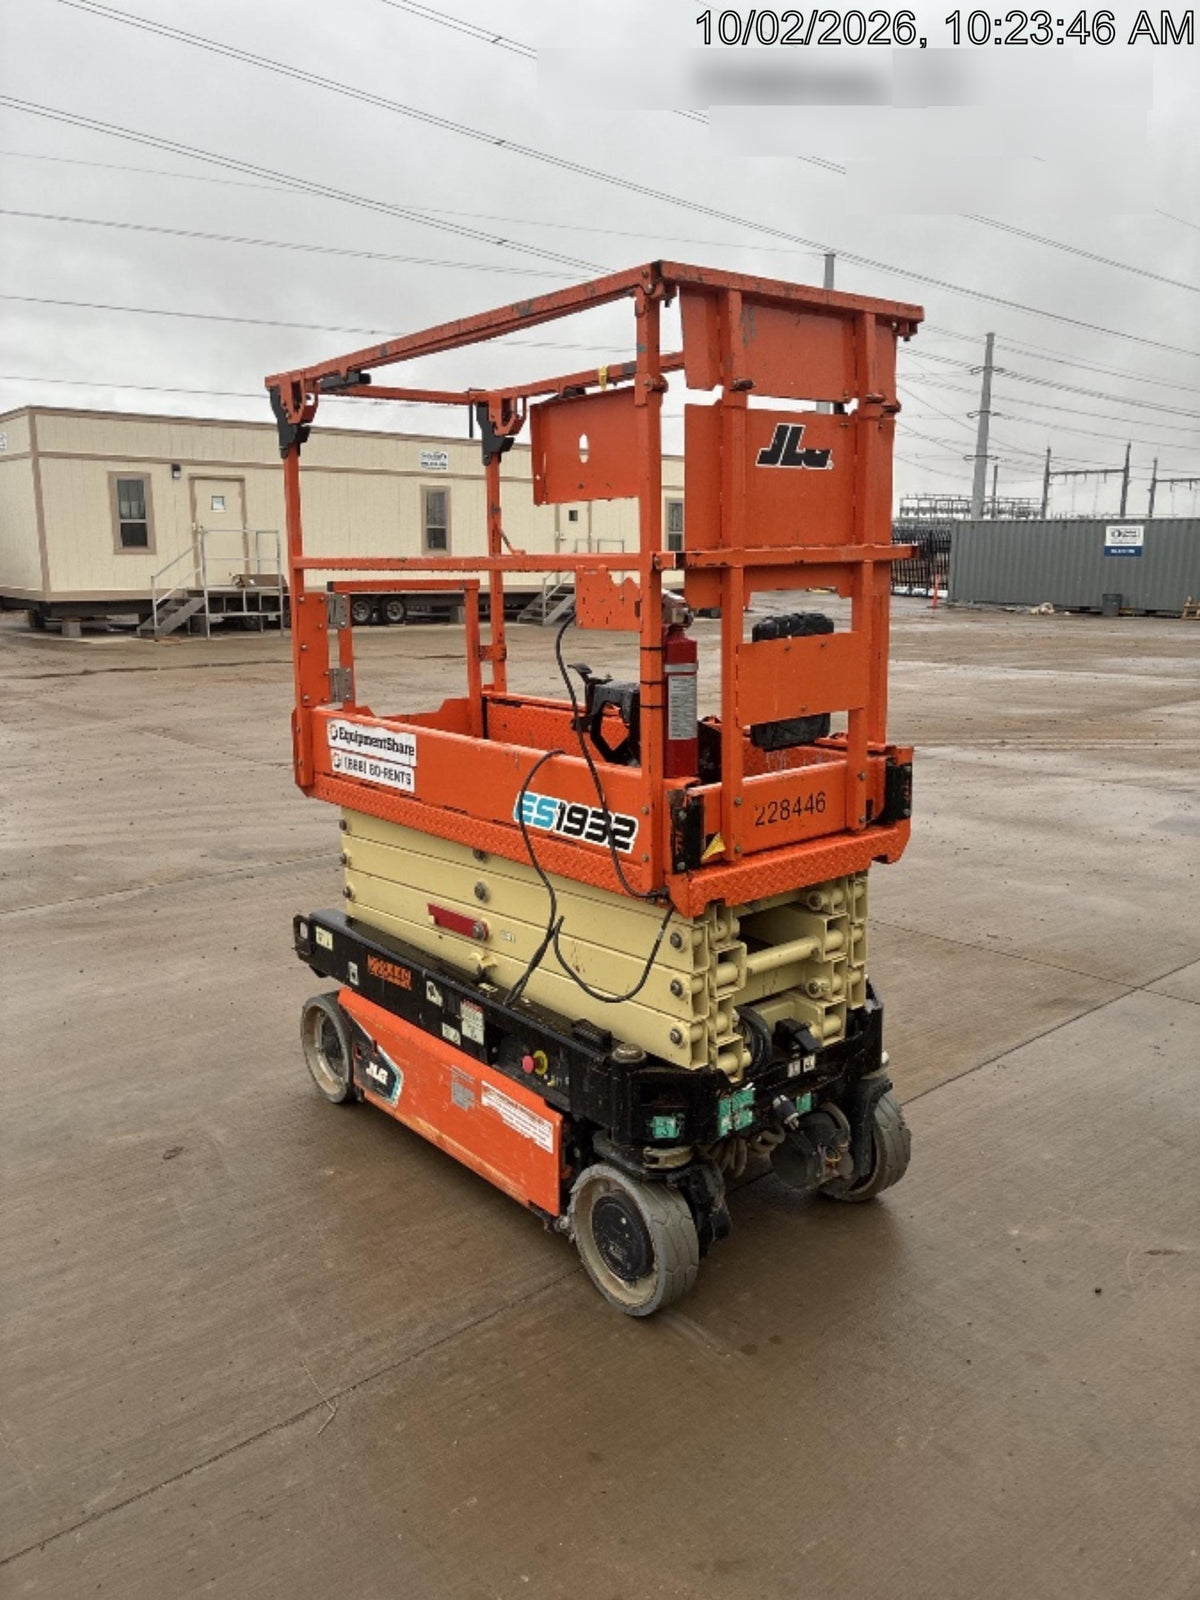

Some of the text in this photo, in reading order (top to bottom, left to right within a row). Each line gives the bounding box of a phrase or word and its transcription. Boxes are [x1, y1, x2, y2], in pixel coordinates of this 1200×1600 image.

[339, 727, 415, 756] EquipmentShare
[513, 793, 638, 851] ES1932
[754, 790, 826, 827] 228446
[365, 1061, 389, 1086] JLG
